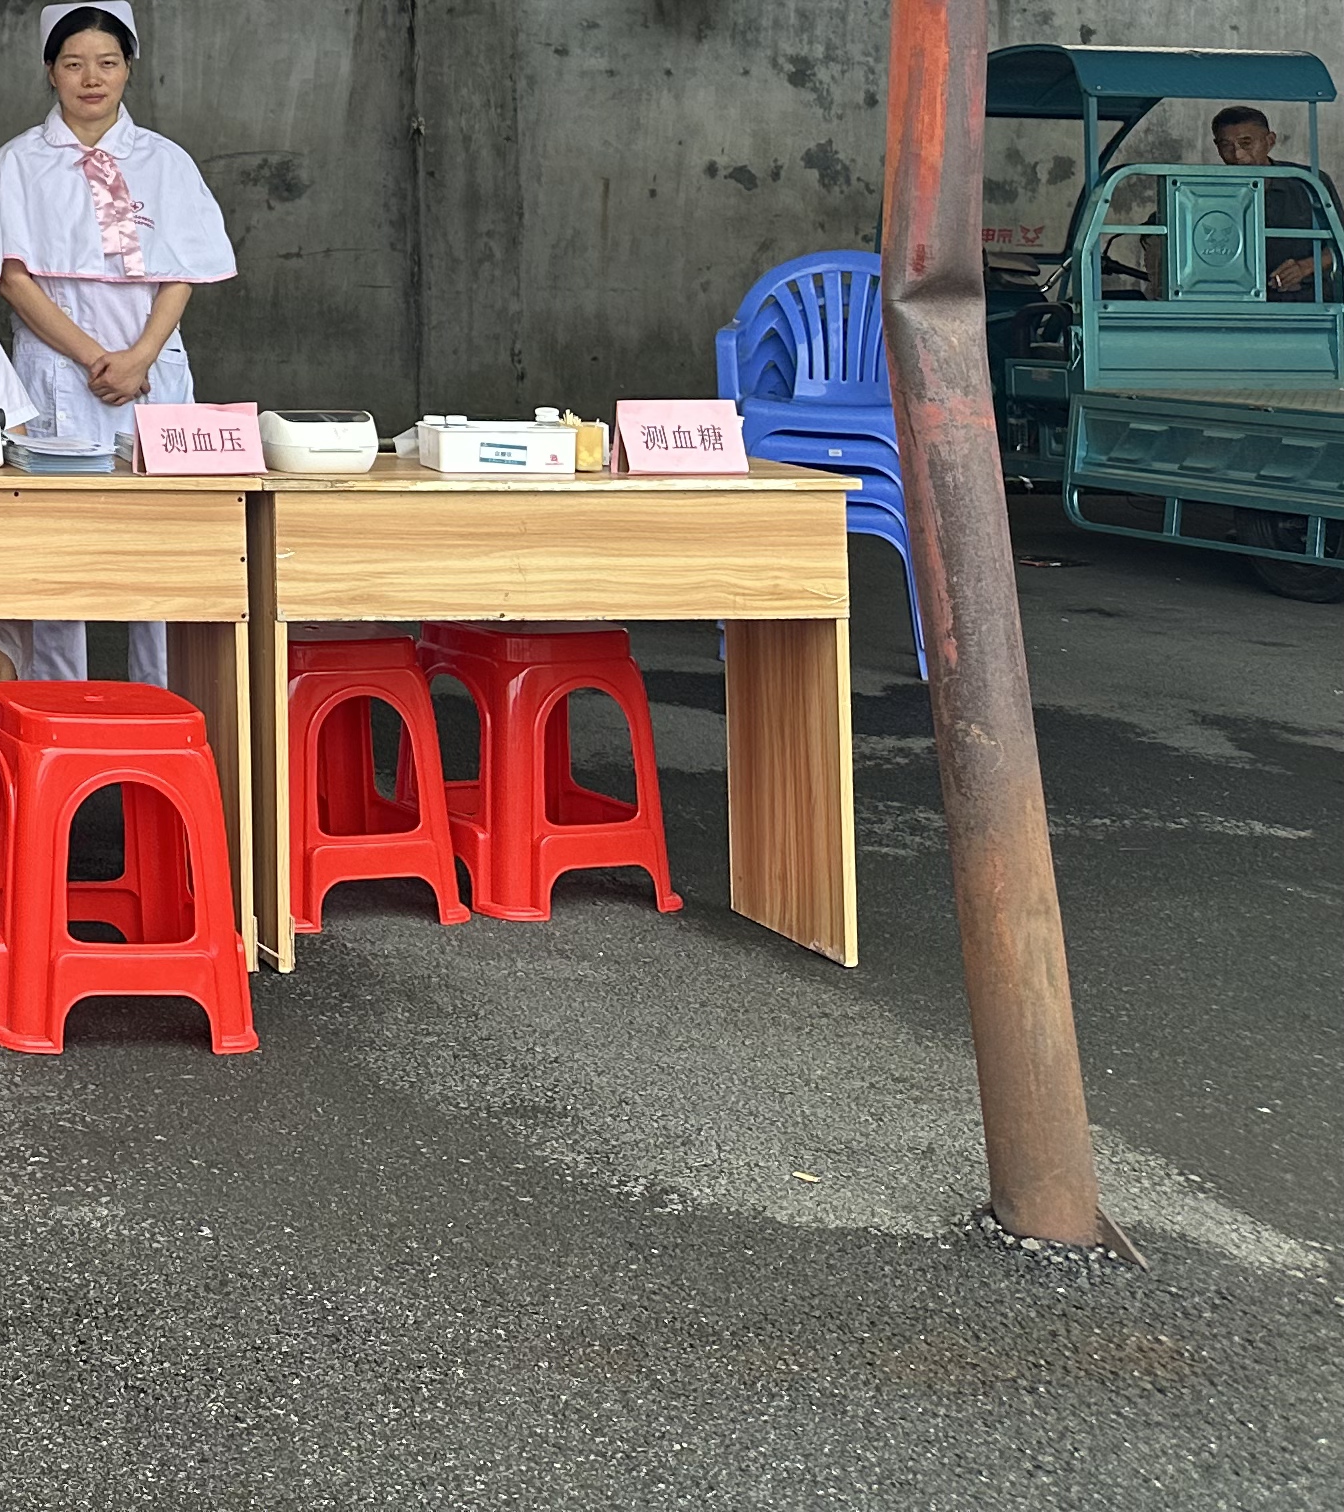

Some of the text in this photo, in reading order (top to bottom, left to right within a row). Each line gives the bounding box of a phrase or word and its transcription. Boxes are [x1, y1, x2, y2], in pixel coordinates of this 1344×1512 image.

[160, 426, 246, 455] 测血压
[640, 423, 724, 451] 测血糖
